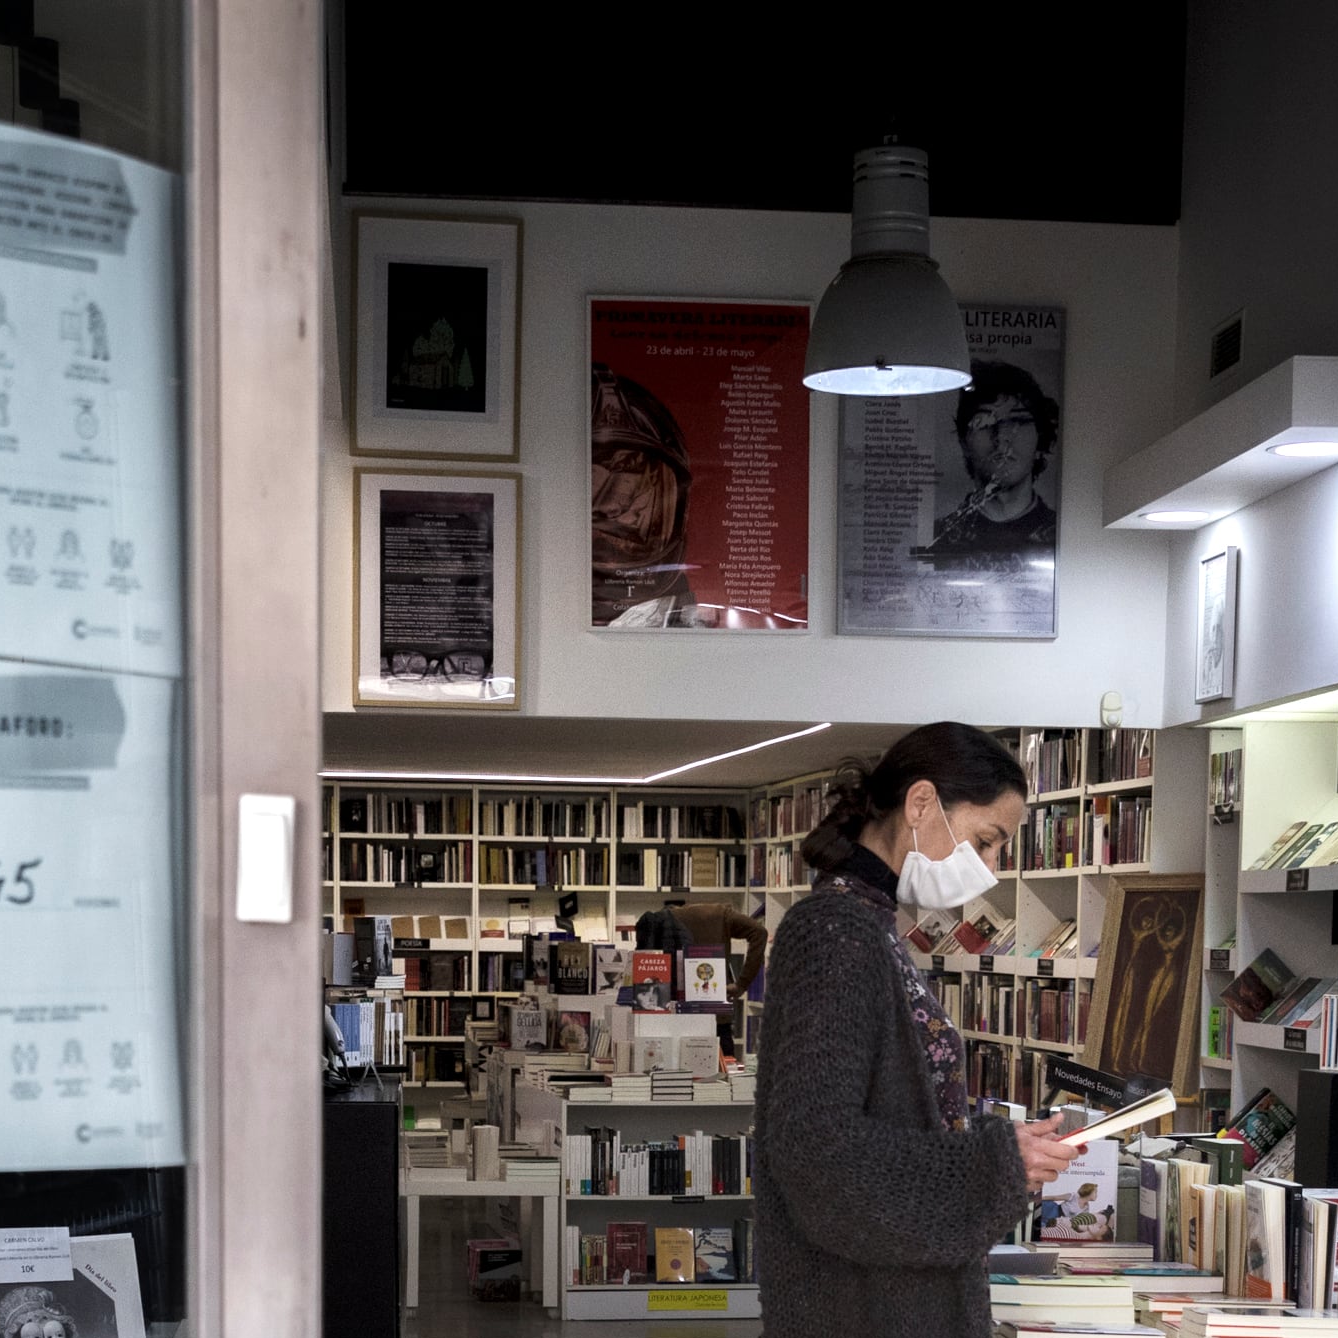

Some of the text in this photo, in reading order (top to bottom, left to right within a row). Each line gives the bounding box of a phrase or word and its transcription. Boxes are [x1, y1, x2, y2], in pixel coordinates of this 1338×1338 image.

[965, 311, 1057, 329] LITERARIA
[988, 333, 1032, 347] propia
[646, 345, 755, 358] 23 de abril 23 de mayo
[722, 520, 753, 528] Margarita
[564, 954, 583, 965] REY
[558, 967, 589, 979] BLANCO
[638, 964, 668, 972] PÁJAROS
[1054, 1067, 1123, 1100] Novedades Ensayo
[21, 1265, 35, 1273] 10€
[103, 1279, 117, 1293] libro
[690, 1294, 727, 1302] JAPONESA
